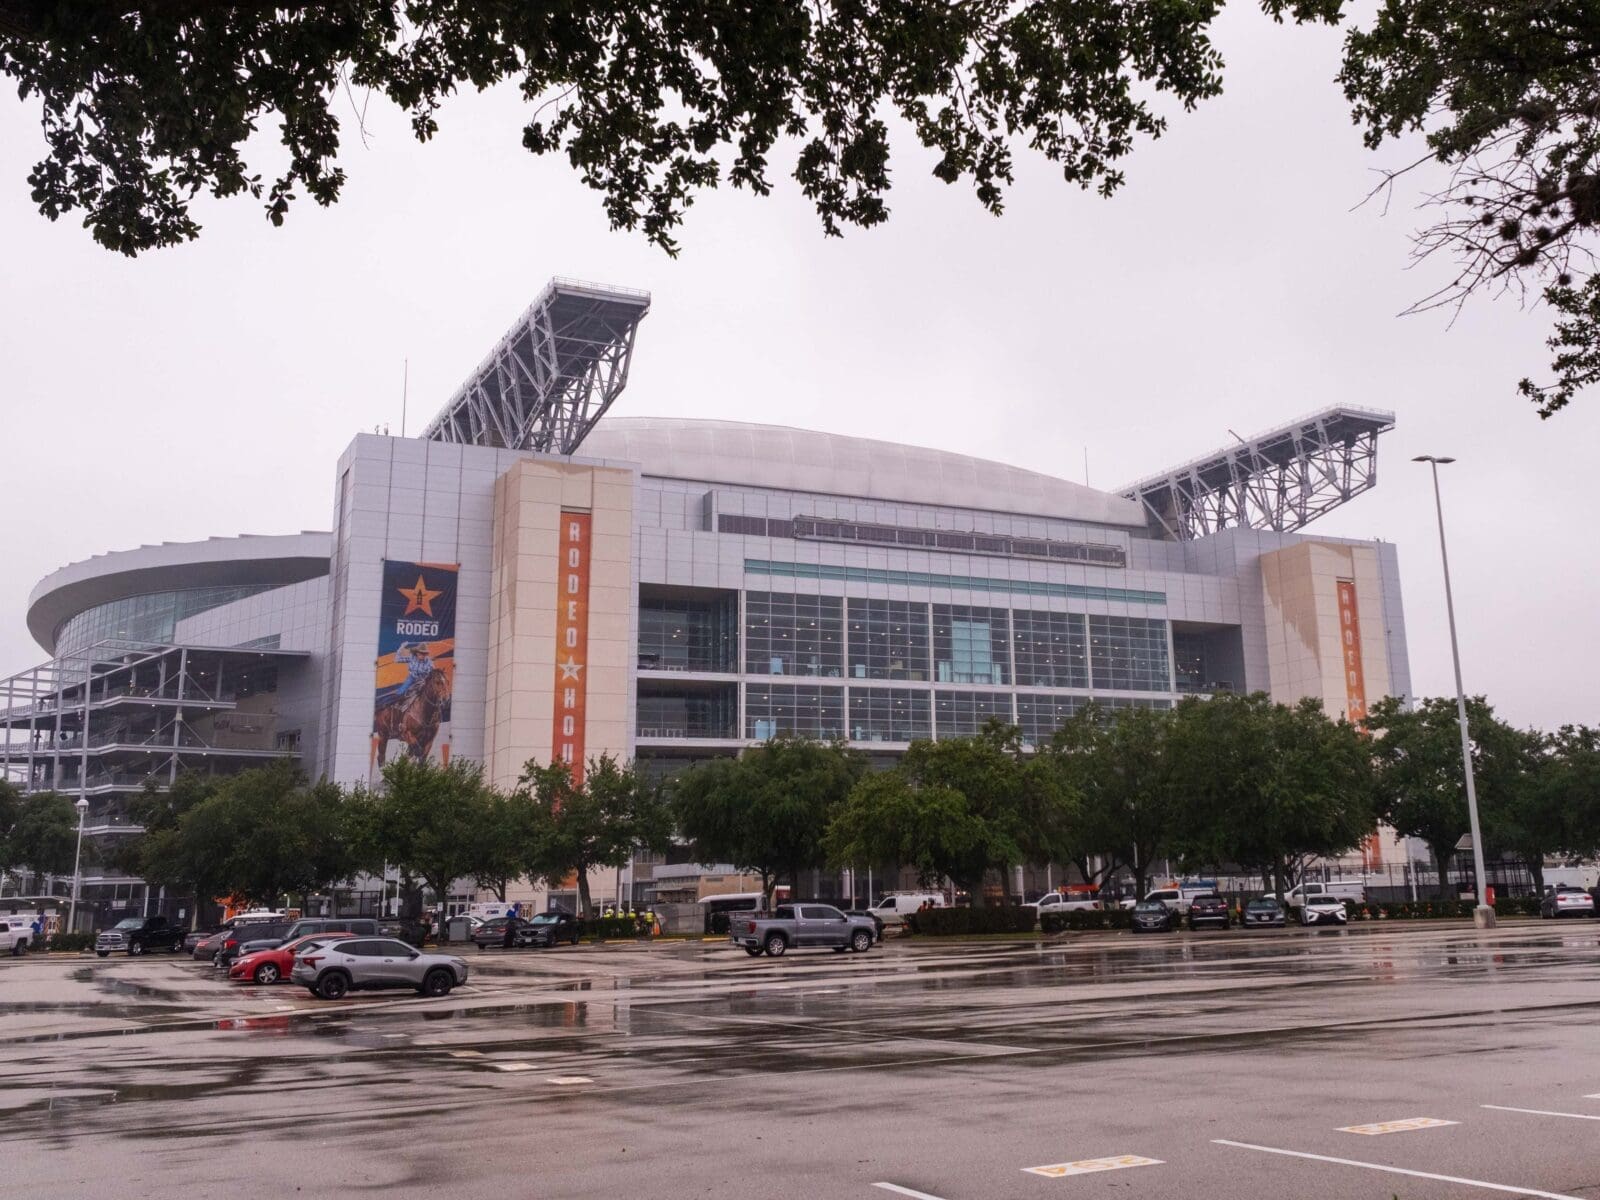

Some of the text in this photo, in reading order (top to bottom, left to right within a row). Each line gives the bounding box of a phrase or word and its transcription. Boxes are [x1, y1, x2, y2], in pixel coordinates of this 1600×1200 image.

[396, 622, 439, 637] RODEO
[566, 522, 580, 648] RODEO
[1342, 589, 1357, 686] RODEO
